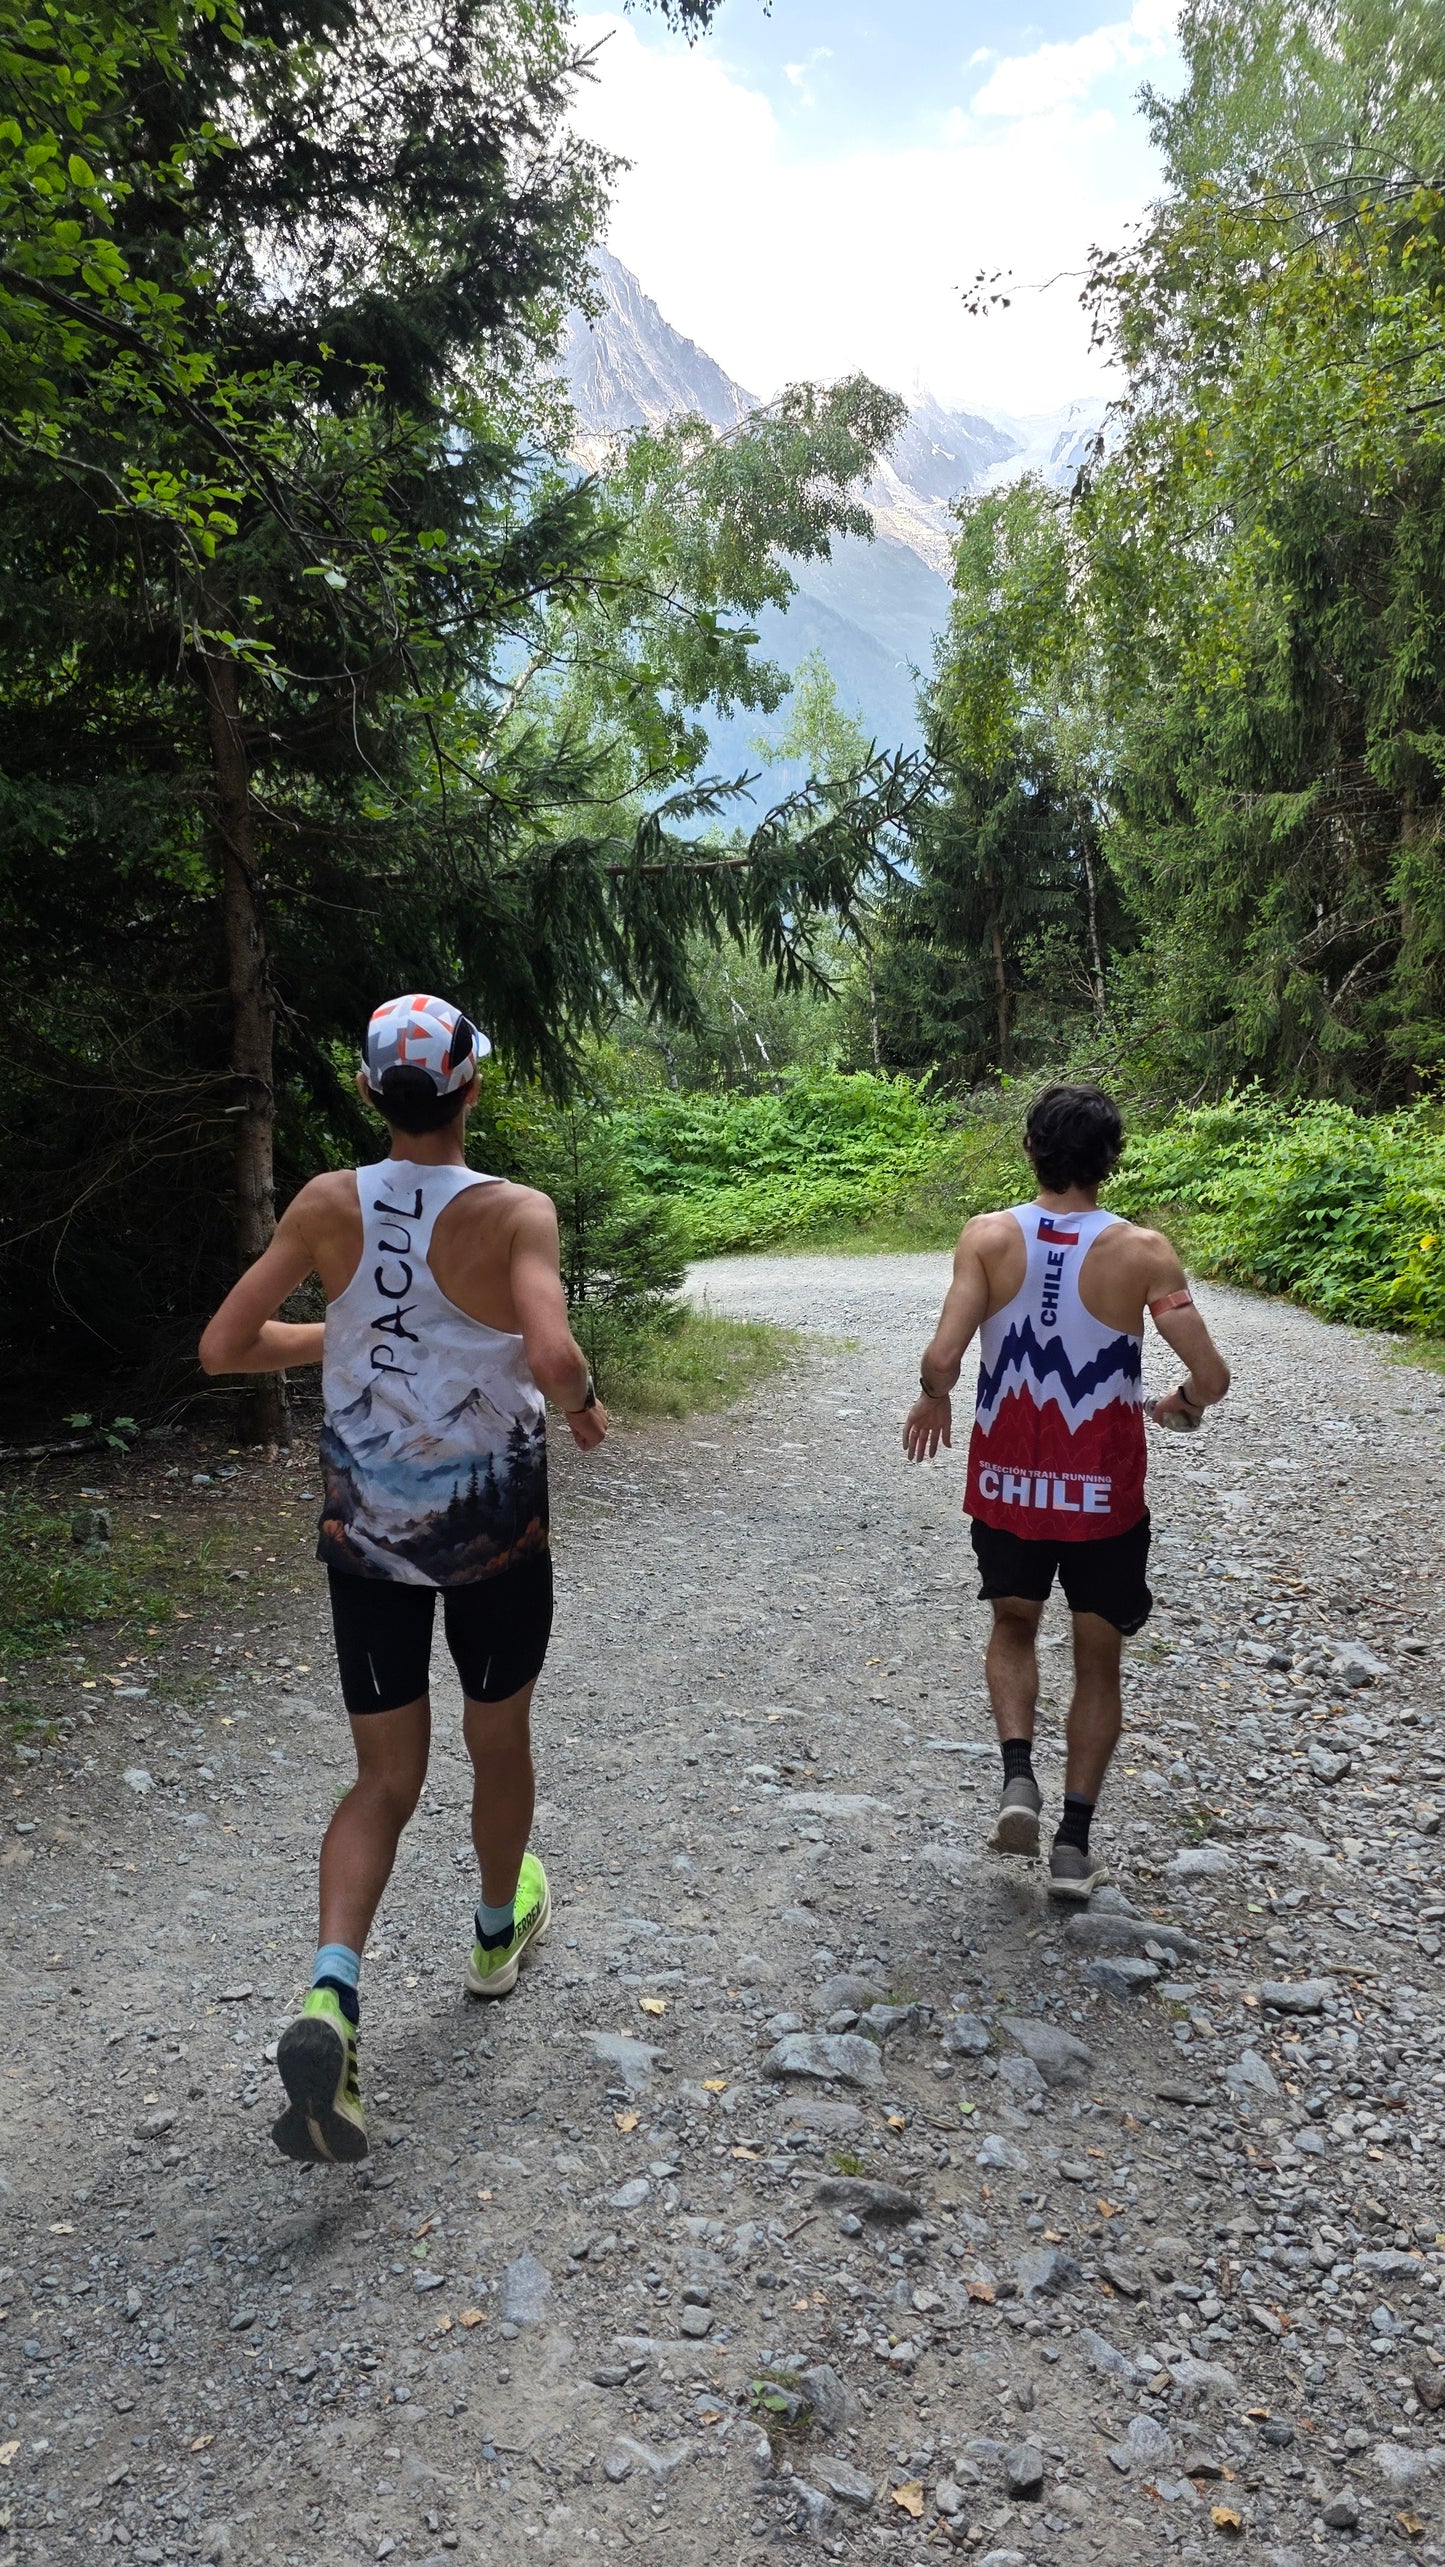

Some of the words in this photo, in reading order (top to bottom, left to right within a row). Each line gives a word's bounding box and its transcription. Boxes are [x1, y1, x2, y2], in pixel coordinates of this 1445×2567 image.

[370, 1188, 423, 1375] PACUL
[1040, 1250, 1065, 1327] CHILE
[978, 1470, 1112, 1514] CHILE
[1028, 1470, 1060, 1480] TRAIL
[1061, 1473, 1112, 1483] RUNNING
